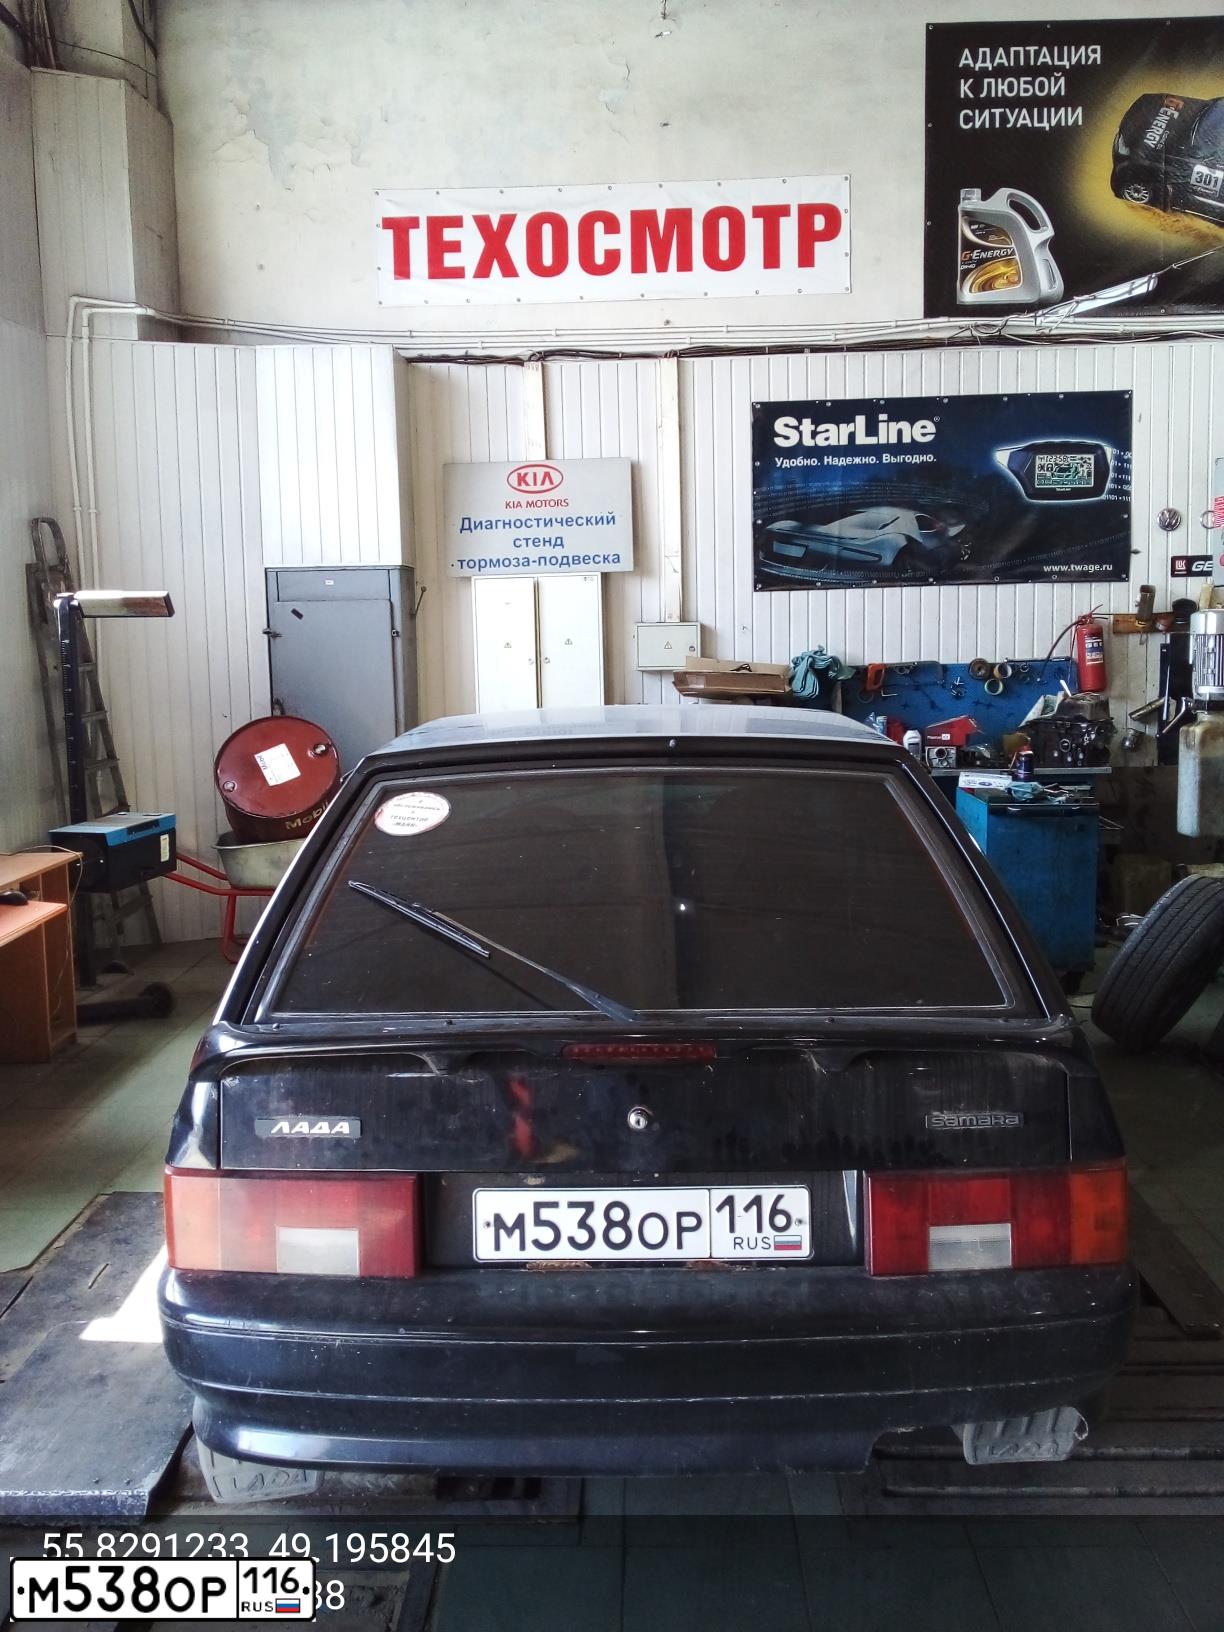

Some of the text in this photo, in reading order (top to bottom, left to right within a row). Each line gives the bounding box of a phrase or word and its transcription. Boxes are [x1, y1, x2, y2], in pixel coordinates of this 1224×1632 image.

[958, 45, 1102, 71] АДАПТАЦИЯ
[960, 72, 1065, 98] К ЛЮБОЙ
[958, 106, 1083, 131] СИТУАЦИИ
[1194, 171, 1219, 189] 301
[381, 202, 842, 281] ТЕХОСМОТР
[773, 413, 937, 448] StarLine
[775, 453, 937, 468] Удобно. Надежно. Выгодно.
[516, 471, 554, 487] KIA
[505, 498, 569, 510] KIA MOTORS
[459, 511, 616, 533] Диагностический
[513, 536, 565, 549] стенд
[457, 552, 621, 572] тормоза-подвеска
[1043, 563, 1113, 573] www.twage.ru
[715, 1193, 792, 1234] 116
[733, 1236, 772, 1250] RUS
